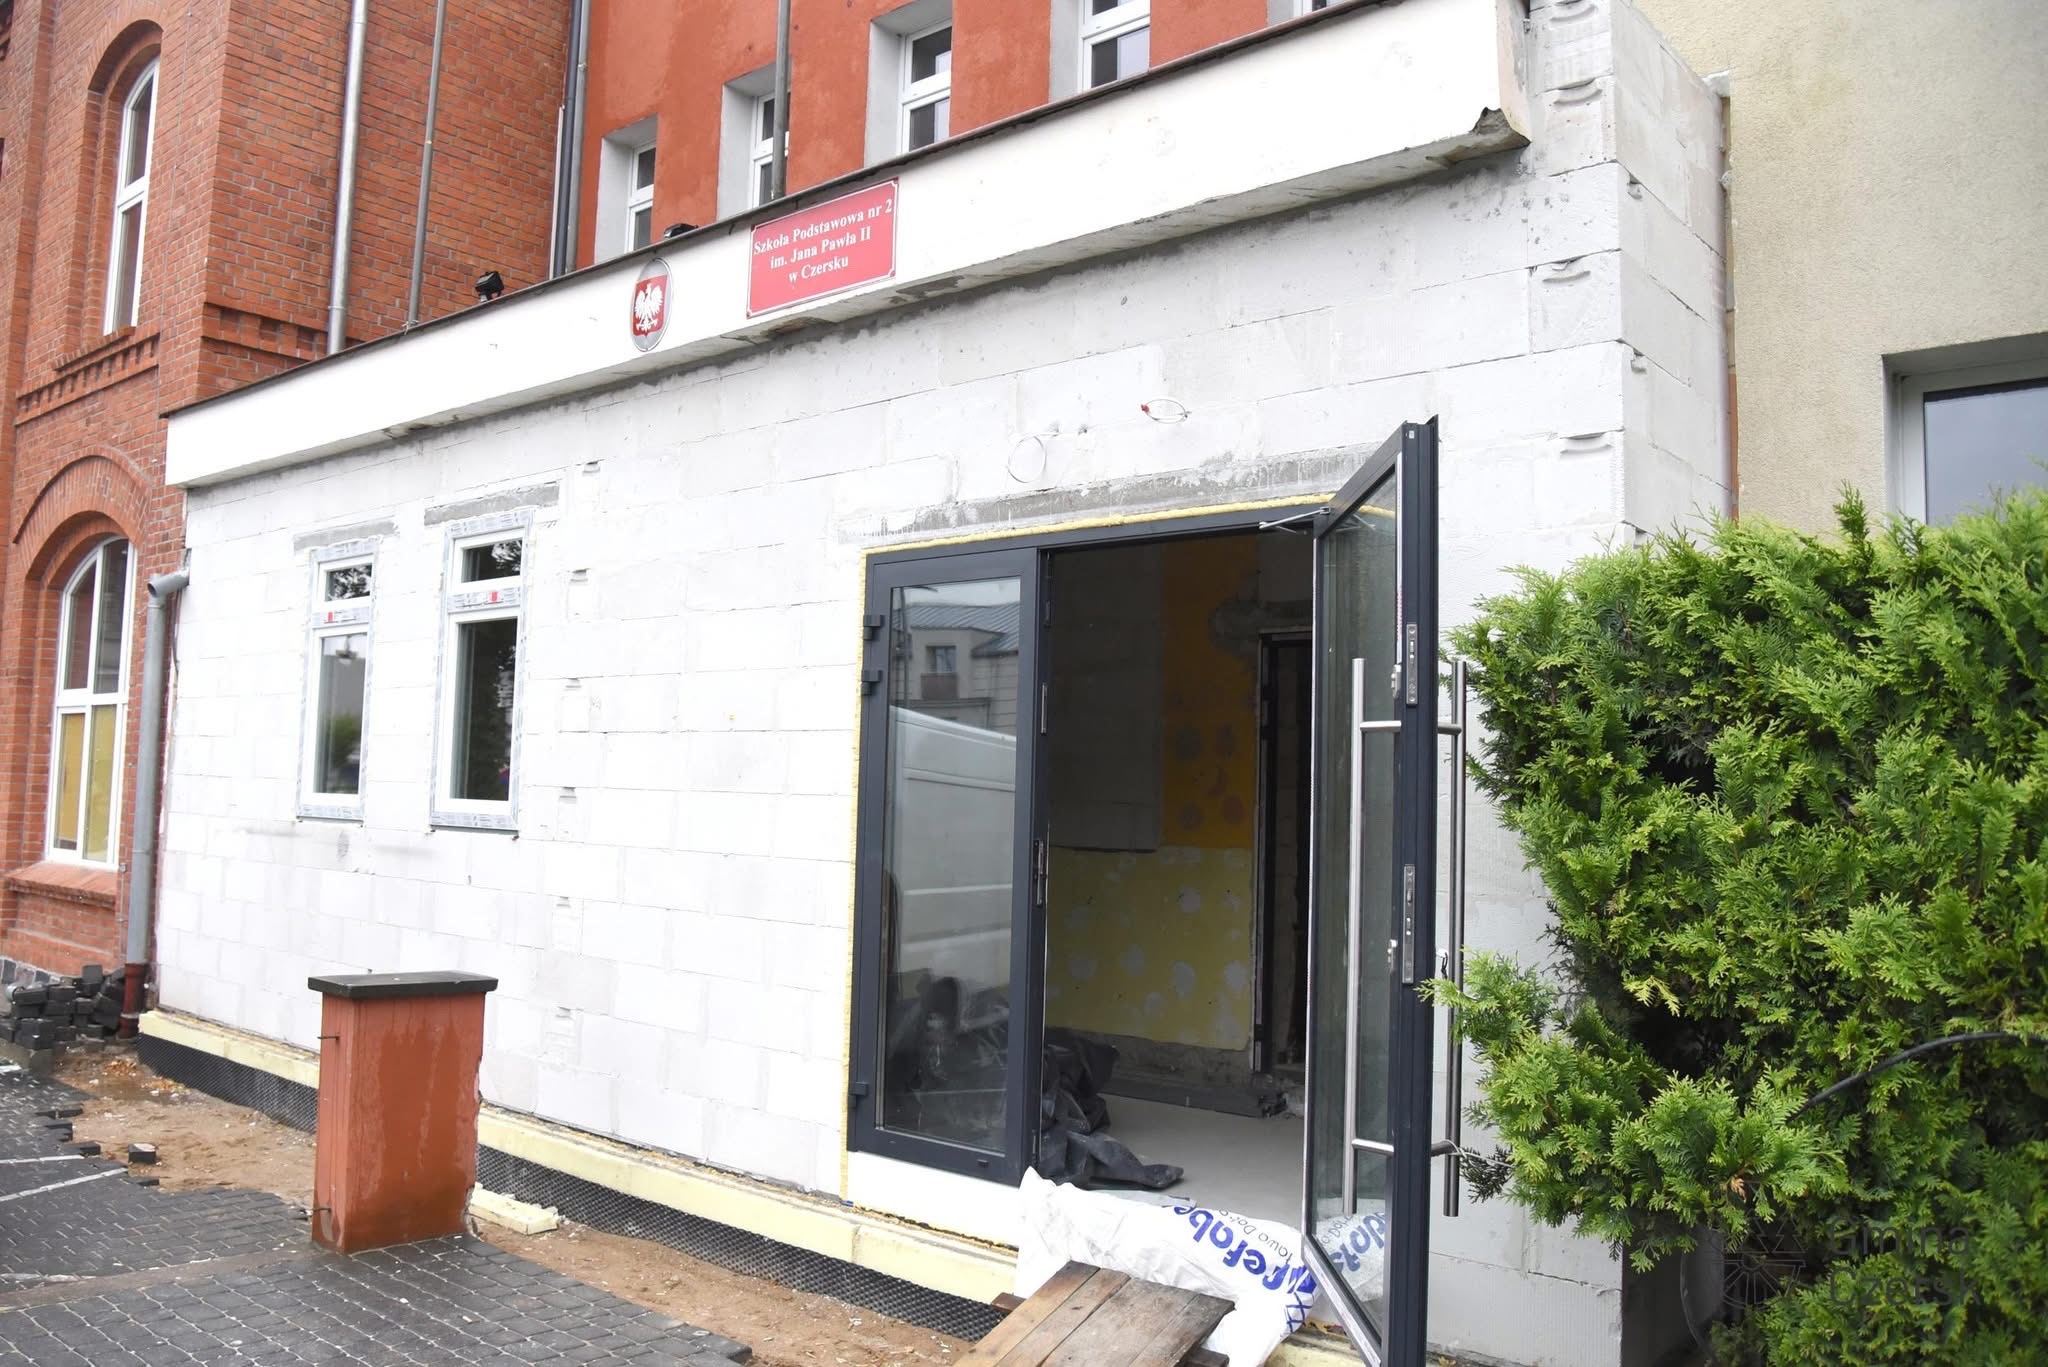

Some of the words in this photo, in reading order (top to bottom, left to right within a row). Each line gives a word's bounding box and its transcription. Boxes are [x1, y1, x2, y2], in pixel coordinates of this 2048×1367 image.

[754, 233, 789, 255] Szkoła
[793, 211, 864, 242] Podstawowa
[868, 205, 882, 218] nr
[884, 199, 892, 213] 2
[770, 255, 787, 269] im.
[791, 245, 817, 264] Jana
[822, 232, 856, 253] Pawła
[860, 226, 871, 241] II
[789, 272, 798, 283] w
[801, 256, 849, 279] Czersku
